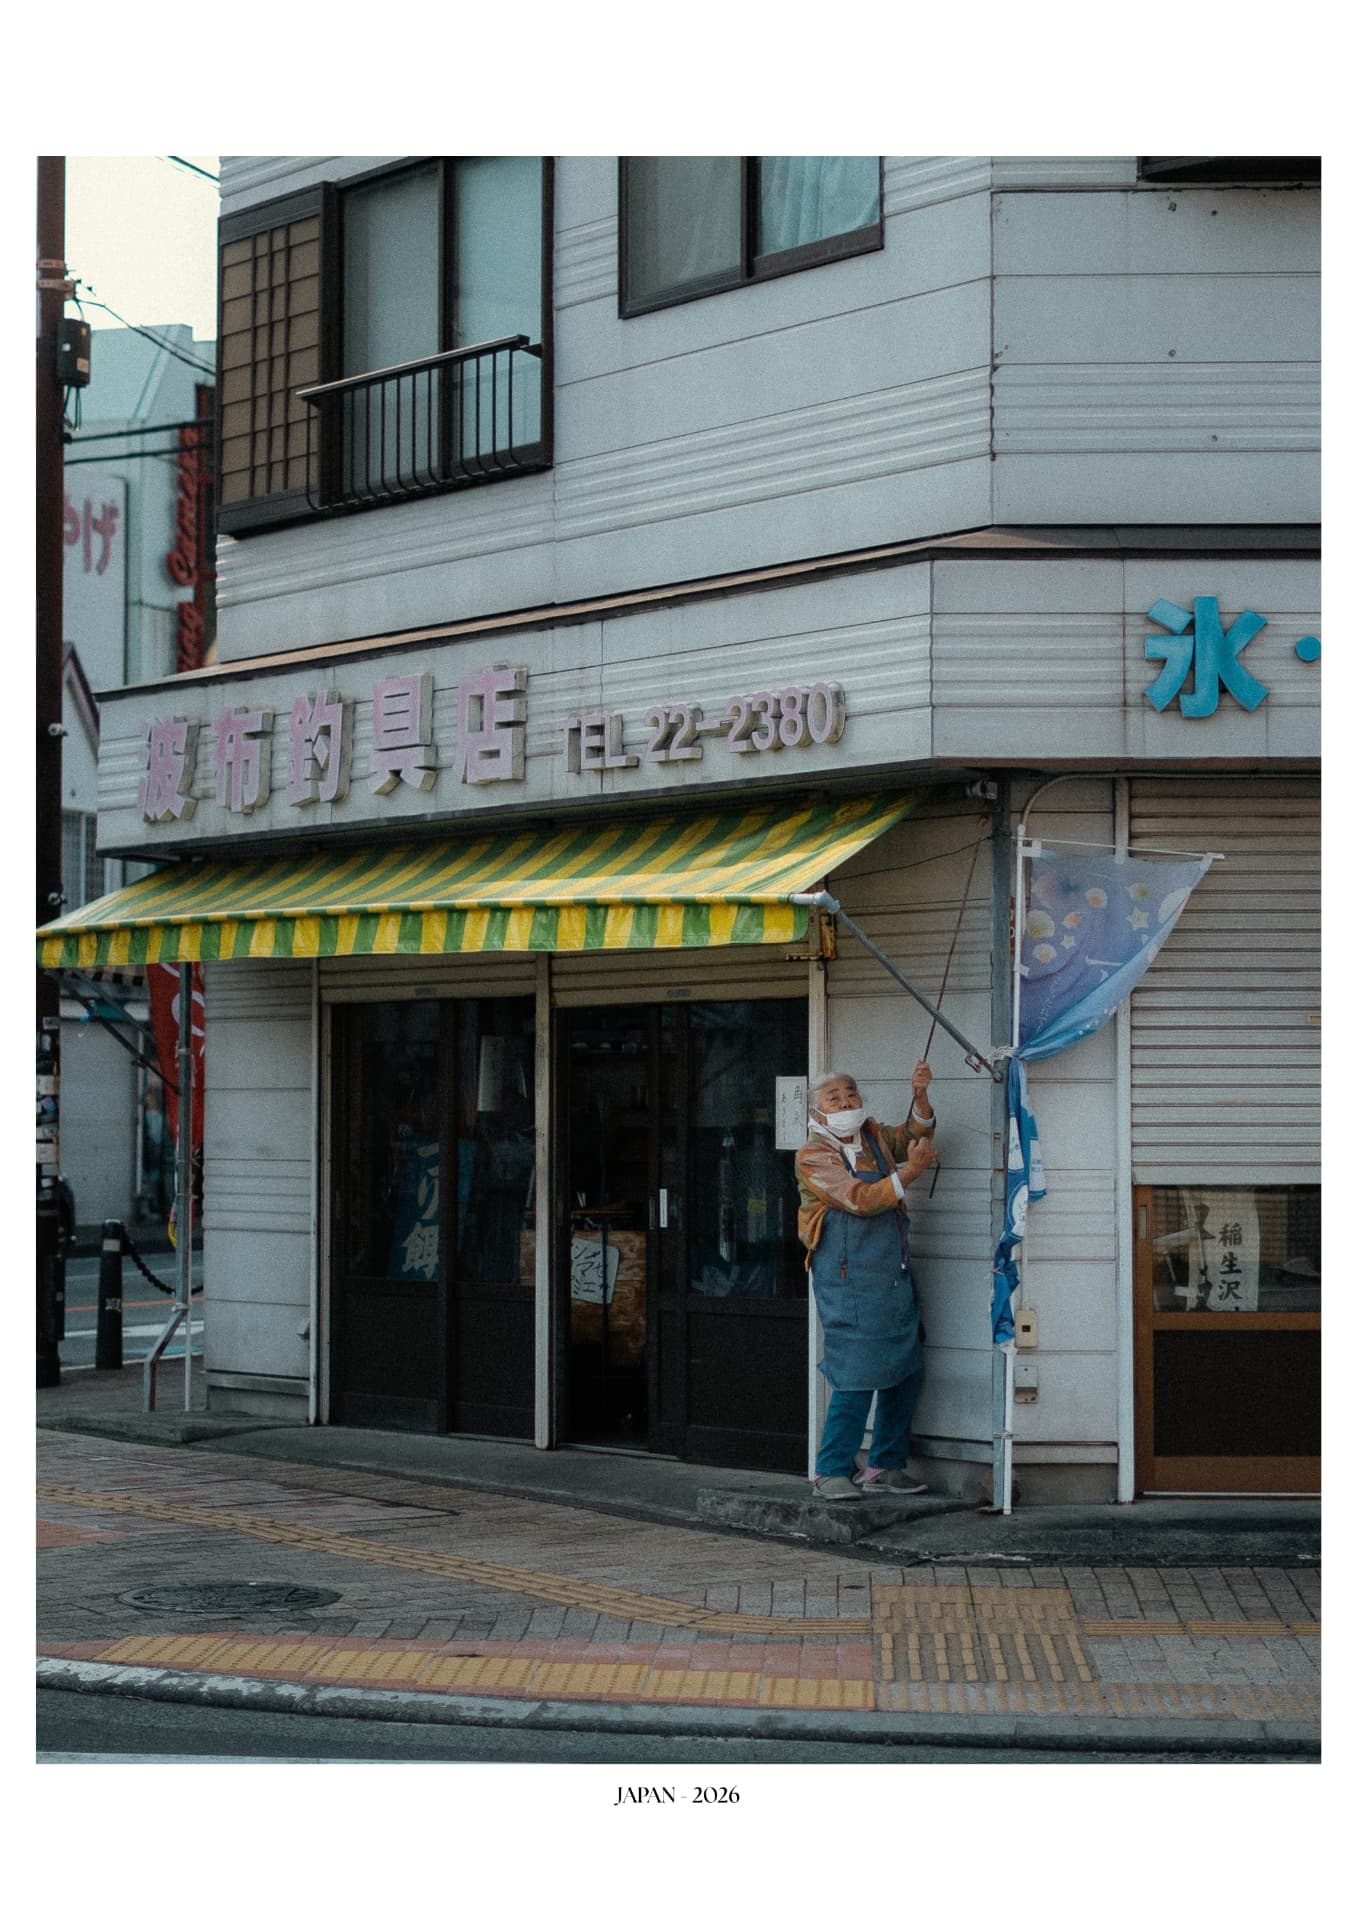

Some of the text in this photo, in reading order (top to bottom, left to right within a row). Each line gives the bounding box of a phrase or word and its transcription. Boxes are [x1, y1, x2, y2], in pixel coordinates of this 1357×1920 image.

[136, 665, 527, 823] 波布釣具店
[644, 681, 846, 763] 22-2380
[1218, 1222, 1244, 1311] 稲生沢
